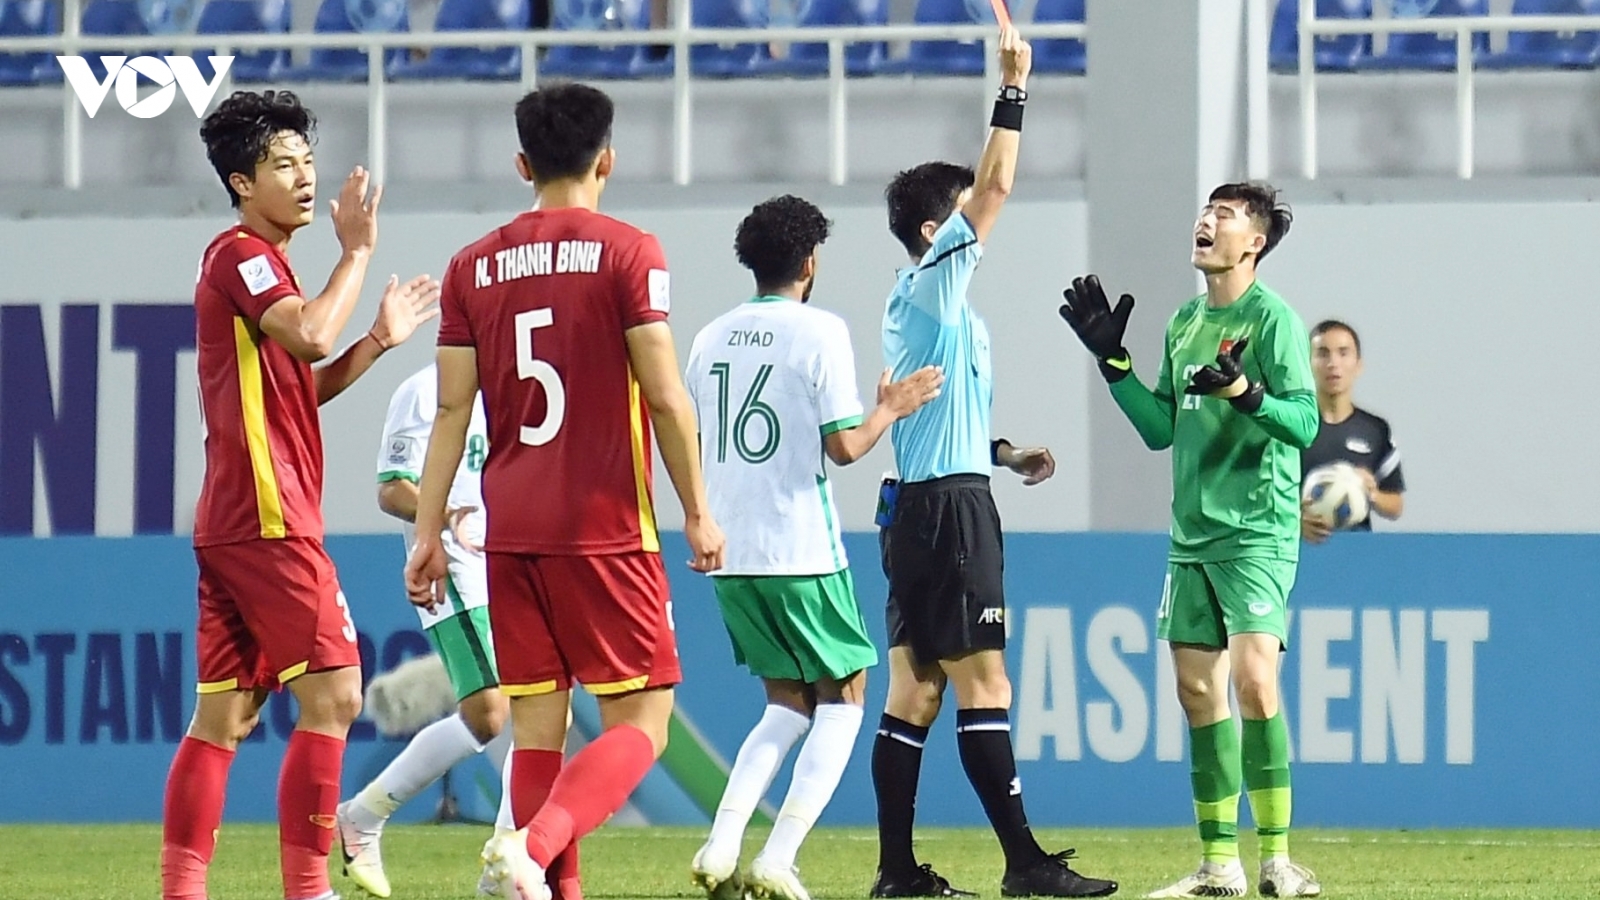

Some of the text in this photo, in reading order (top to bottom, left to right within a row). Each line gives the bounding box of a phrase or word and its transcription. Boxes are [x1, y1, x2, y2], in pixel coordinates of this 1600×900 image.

[475, 240, 602, 289] N. THANH BINH
[727, 330, 774, 347] ZIYAD
[515, 307, 566, 447] 5
[708, 362, 781, 465] 16
[977, 607, 1003, 625] AFC
[1004, 607, 1490, 765] ASENT
